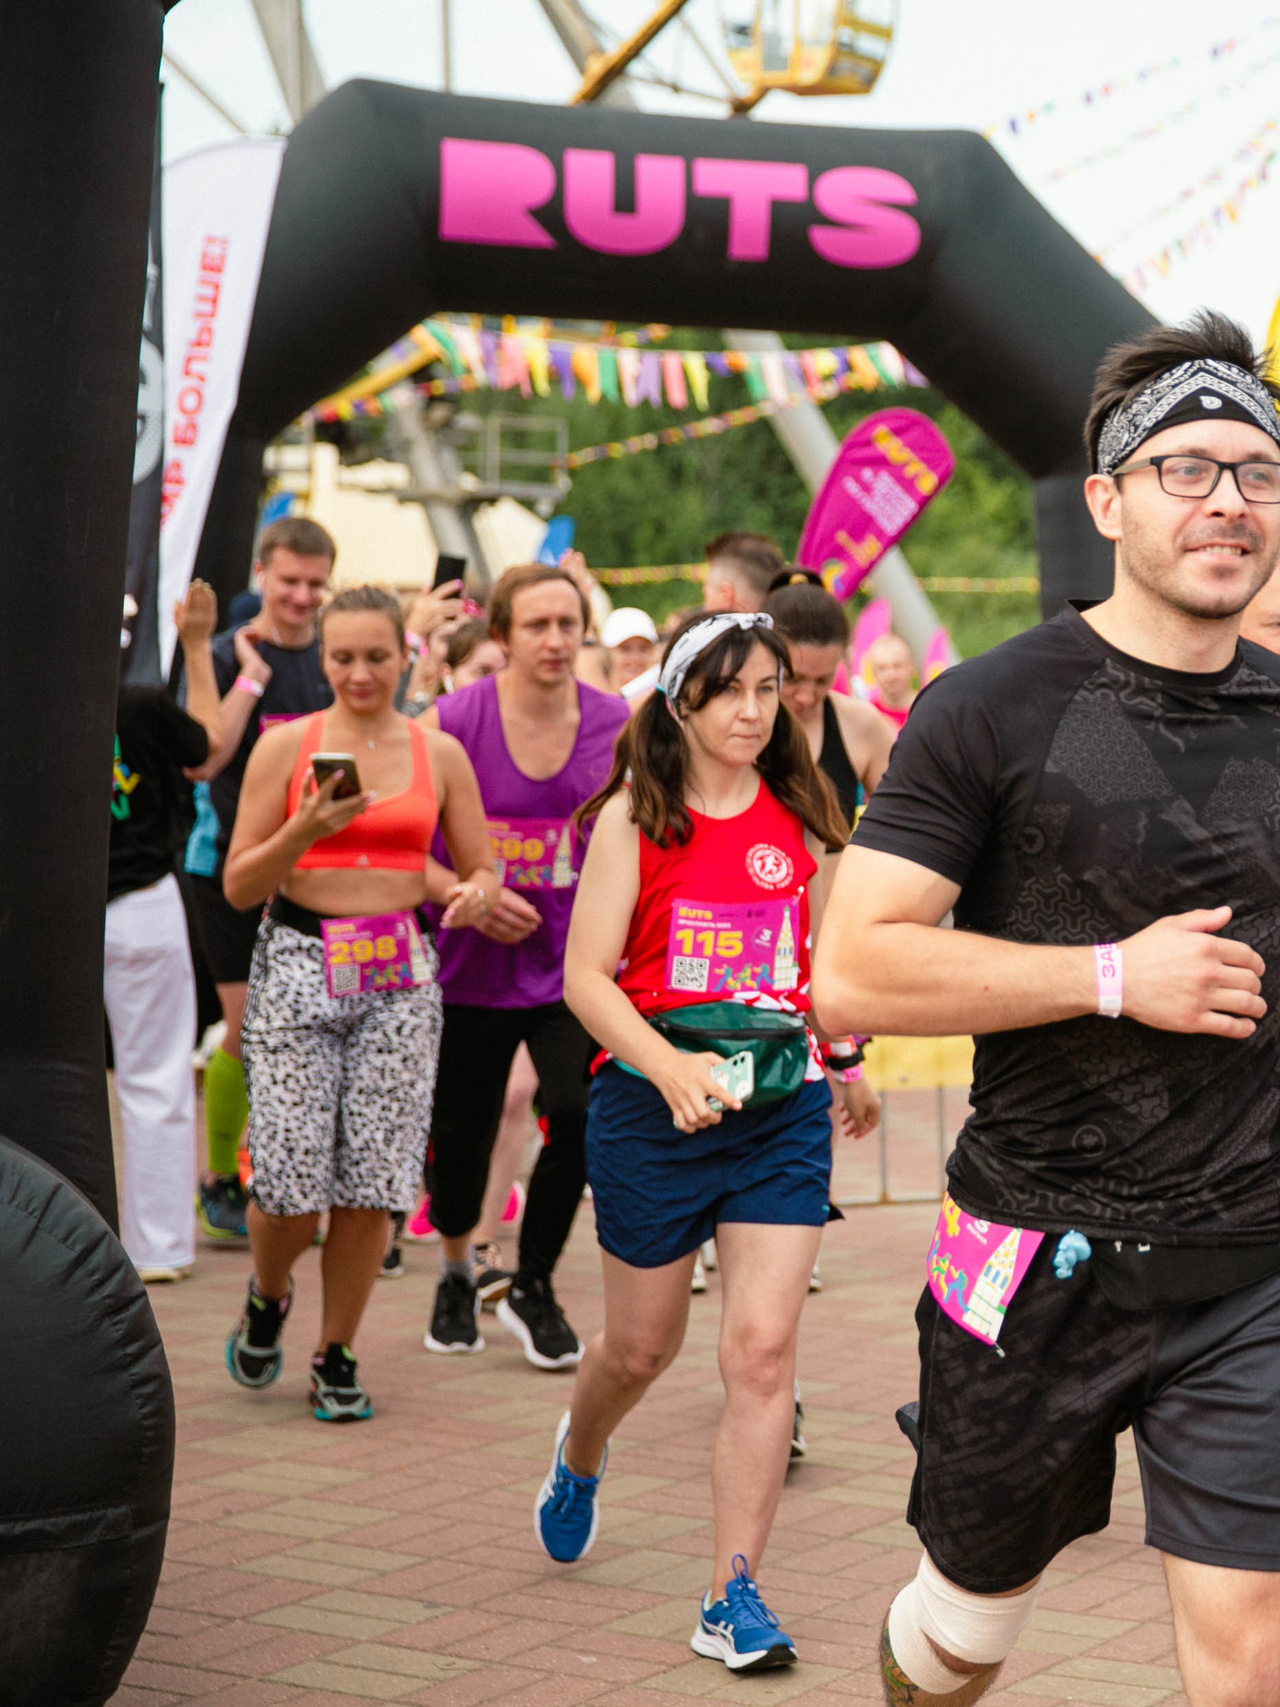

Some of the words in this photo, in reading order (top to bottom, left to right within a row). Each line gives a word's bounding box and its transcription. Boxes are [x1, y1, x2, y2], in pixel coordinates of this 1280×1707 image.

[438, 137, 922, 271] RUTS
[173, 235, 229, 449] БОЛЬШЕ!
[328, 934, 398, 965] 298
[675, 928, 744, 958] 115
